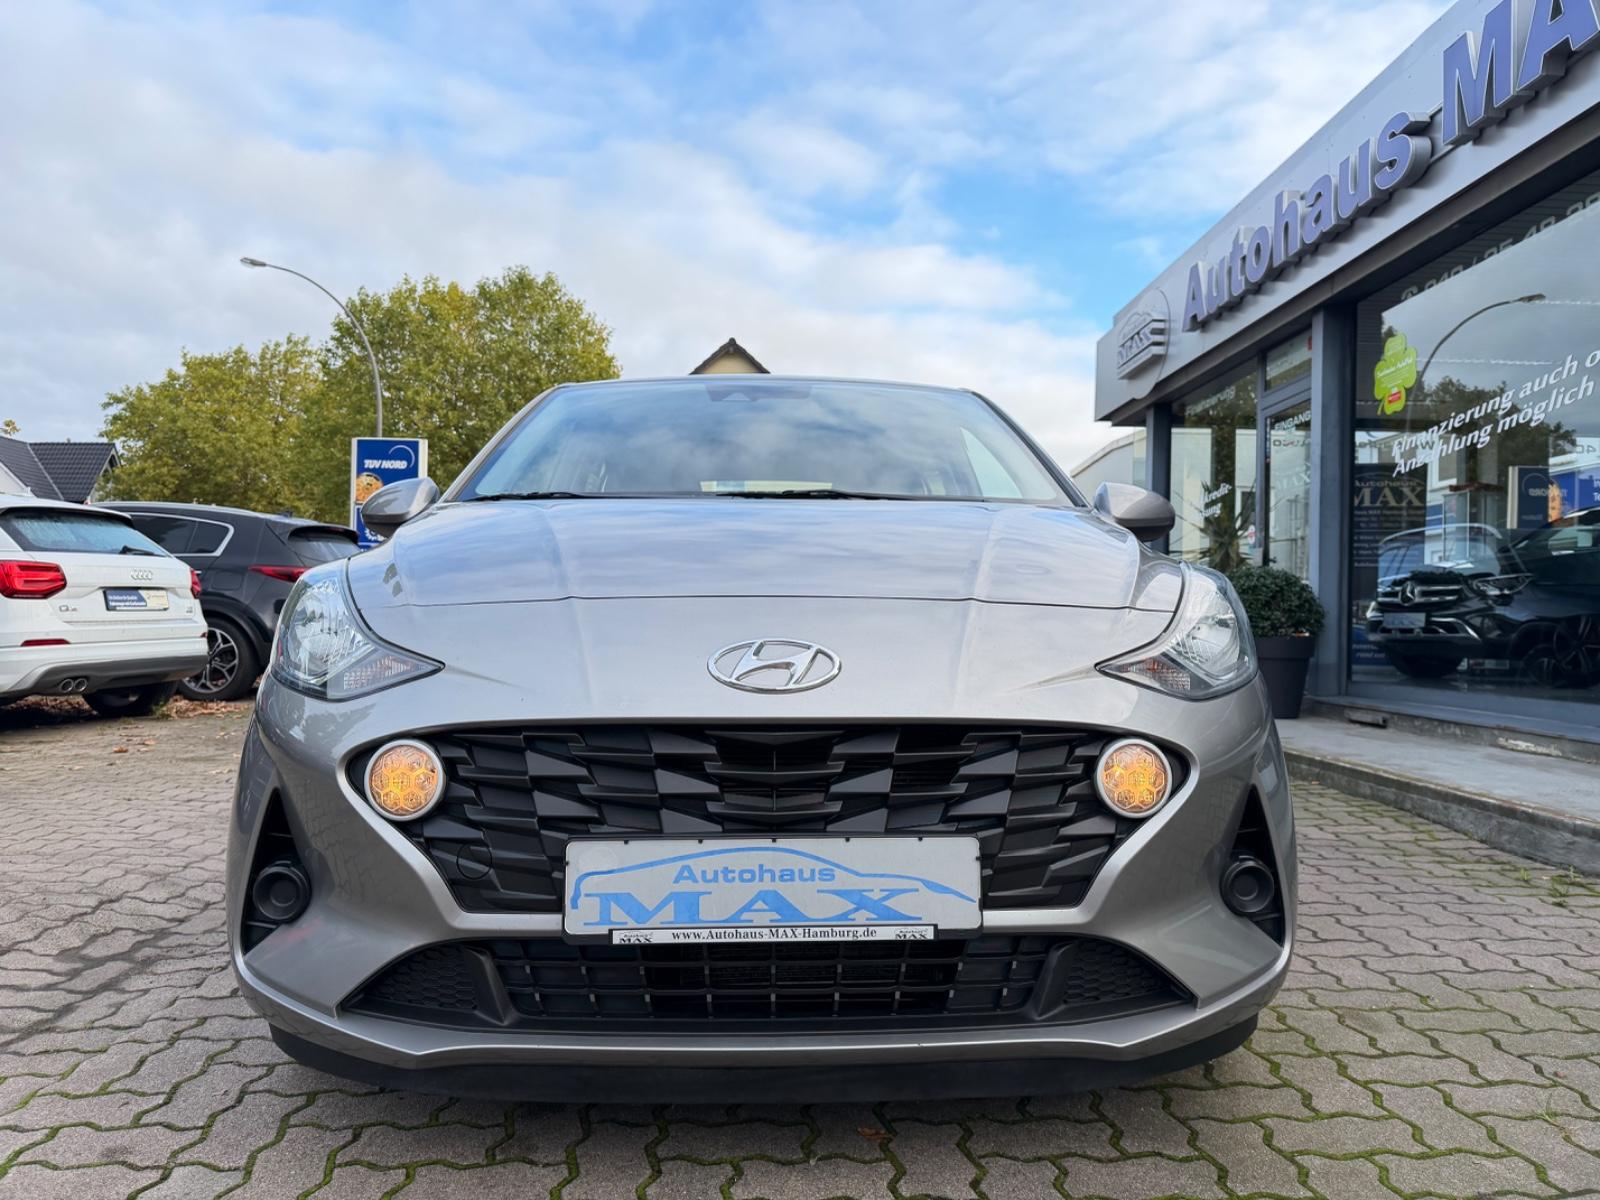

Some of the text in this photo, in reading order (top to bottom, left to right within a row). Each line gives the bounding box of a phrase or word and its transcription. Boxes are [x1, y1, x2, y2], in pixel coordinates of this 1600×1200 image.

[1182, 111, 1424, 332] Autohaus
[1392, 389, 1514, 457] Finanzierung
[1518, 354, 1577, 399] auch
[1497, 375, 1595, 427] möglich
[1274, 410, 1311, 431] EINGANG
[381, 459, 408, 470] NORD
[673, 863, 836, 885] Autohaus
[583, 888, 922, 926] MAX
[671, 928, 877, 940] www.Autohaus-MAX-Hamburg.de
